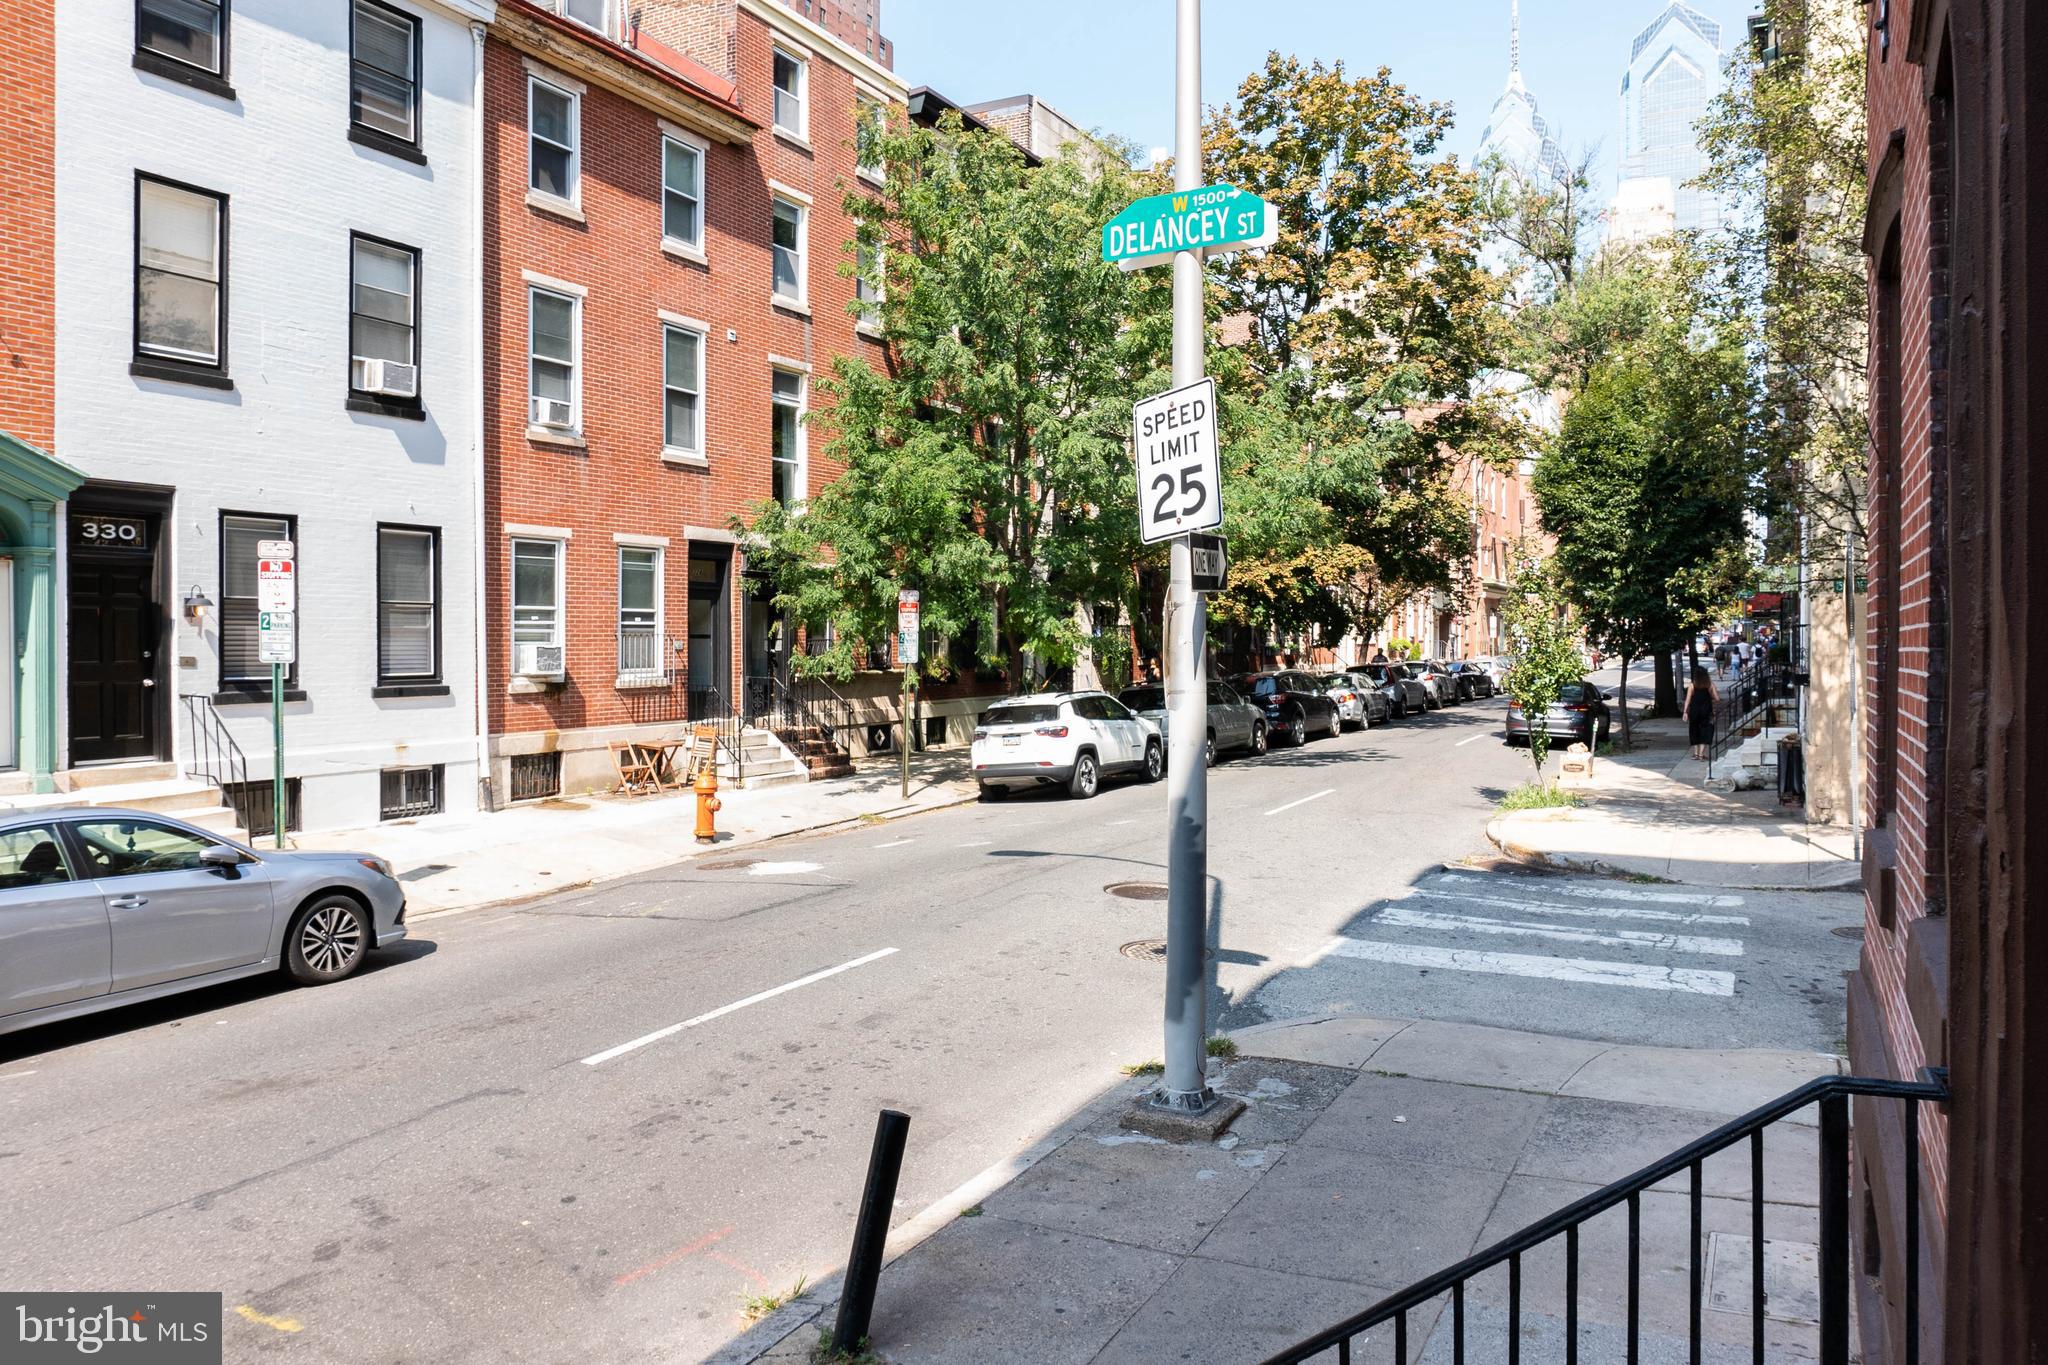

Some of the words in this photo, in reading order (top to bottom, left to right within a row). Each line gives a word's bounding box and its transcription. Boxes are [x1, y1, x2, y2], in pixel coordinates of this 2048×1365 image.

[1172, 195, 1188, 213] W
[1193, 191, 1226, 206] 1500
[1110, 207, 1230, 257] DELANCEY
[1237, 211, 1257, 235] ST
[1143, 400, 1205, 437] SPEED
[1150, 431, 1200, 465] LIMIT
[1151, 464, 1207, 524] 25
[82, 522, 136, 540] 330
[269, 561, 282, 571] NO
[1194, 550, 1207, 573] ONE
[1207, 551, 1219, 573] WAY
[262, 615, 270, 628] 2
